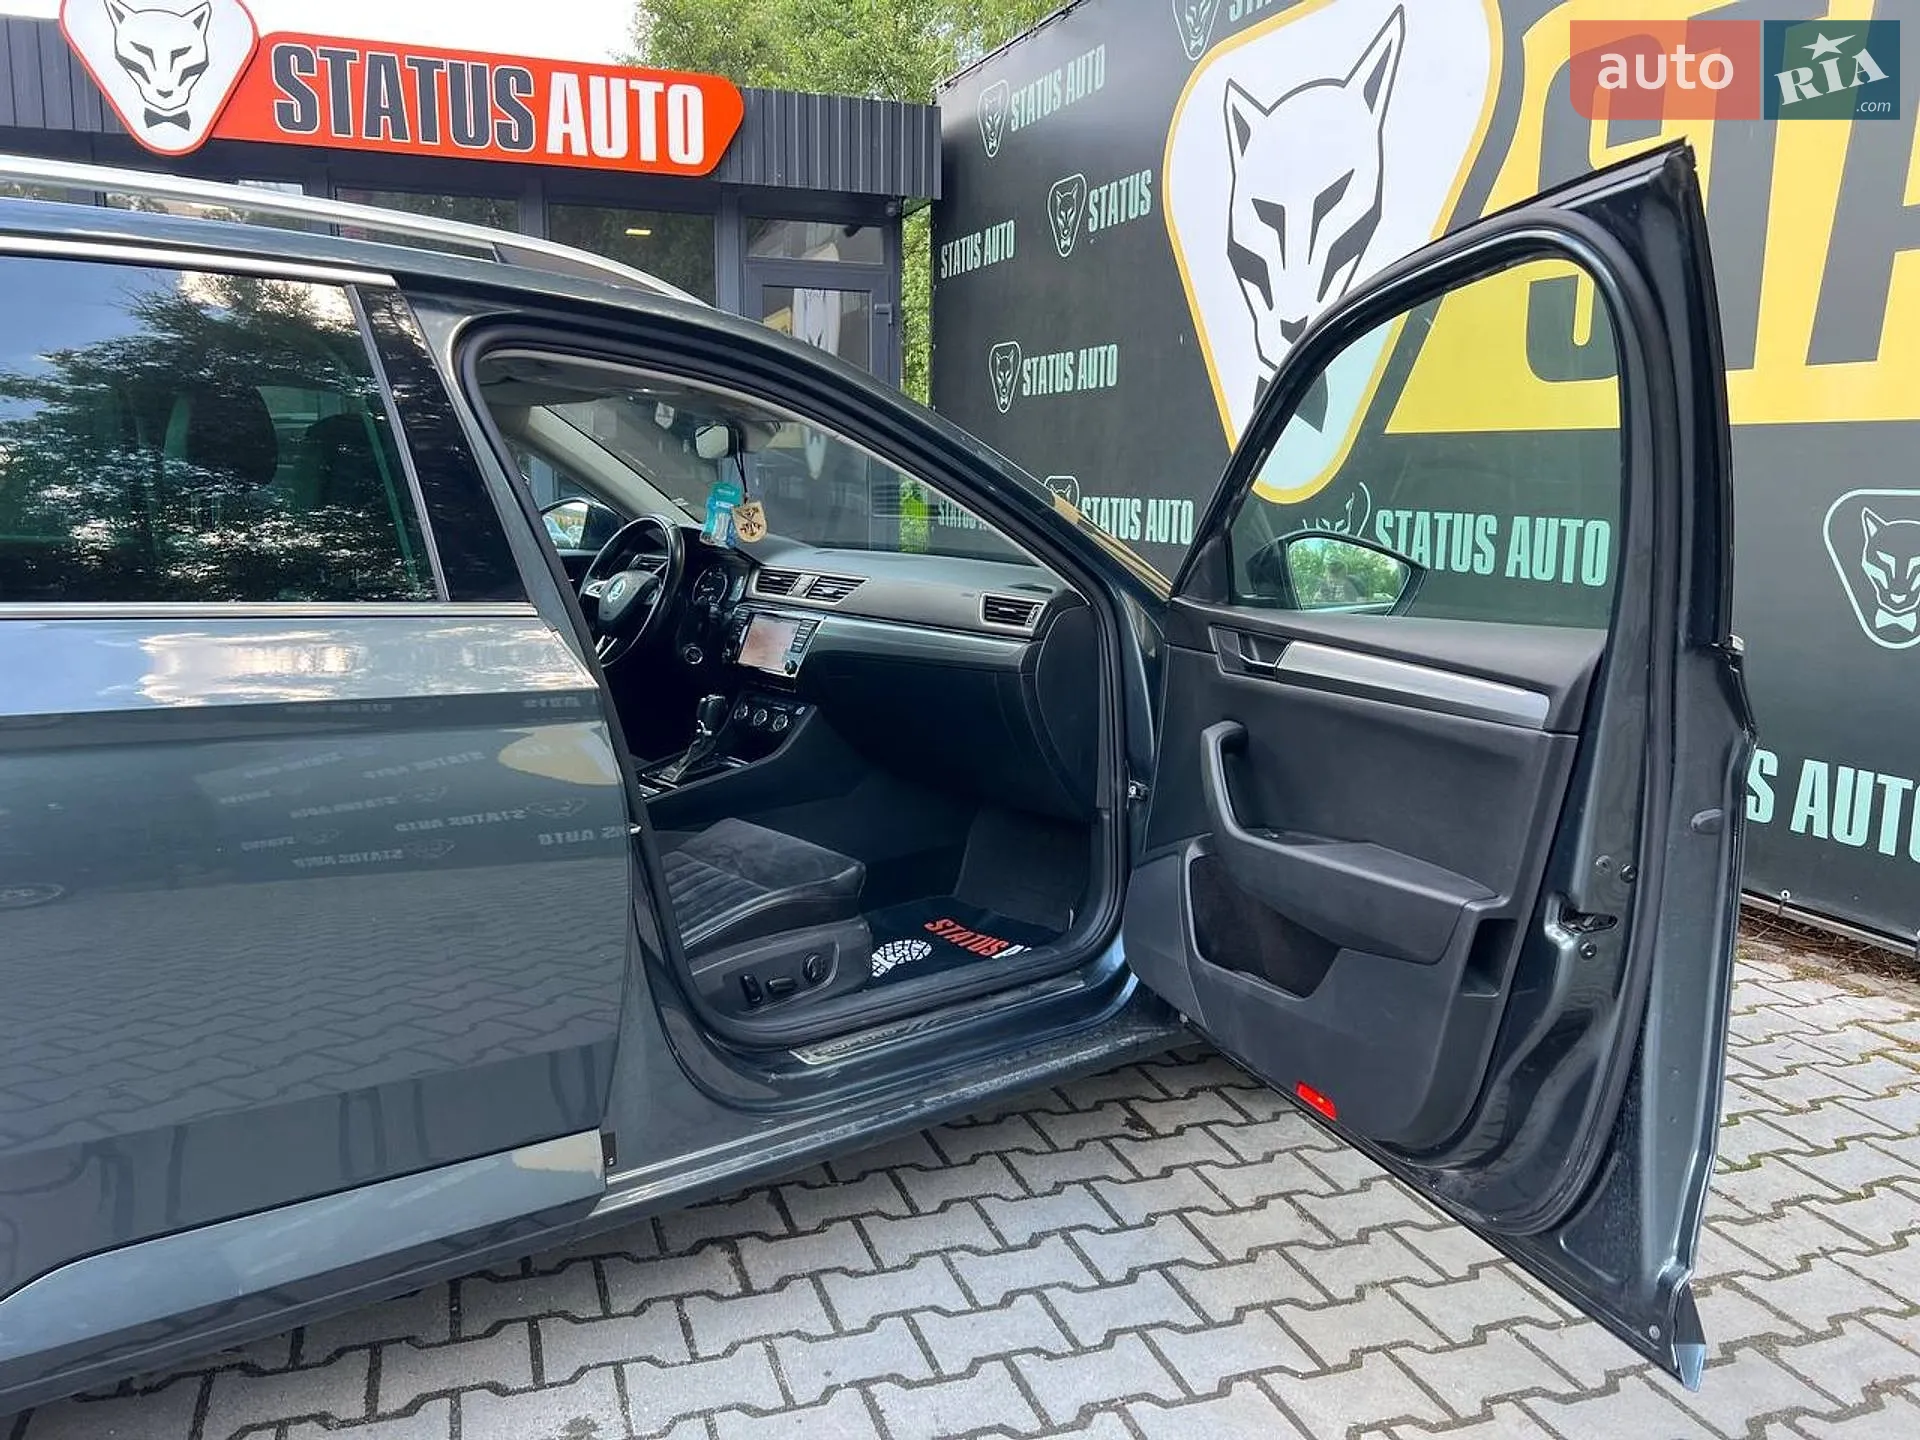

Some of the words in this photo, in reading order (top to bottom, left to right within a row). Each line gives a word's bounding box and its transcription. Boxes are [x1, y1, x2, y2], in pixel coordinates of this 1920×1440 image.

[272, 41, 537, 153] STATUS
[547, 72, 705, 165] AUTO
[1010, 69, 1062, 132] STATUS
[1066, 44, 1106, 106] AUTO
[1088, 169, 1152, 233] STATUS
[940, 230, 981, 279] STATUS
[984, 219, 1015, 266] AUTO
[1022, 347, 1074, 396] STATUS
[1077, 344, 1119, 390] AUTO
[1145, 499, 1195, 545] AUTO
[1505, 516, 1612, 588] AUTO
[1790, 758, 1920, 865] AUT
[923, 918, 1009, 956] STATUS
